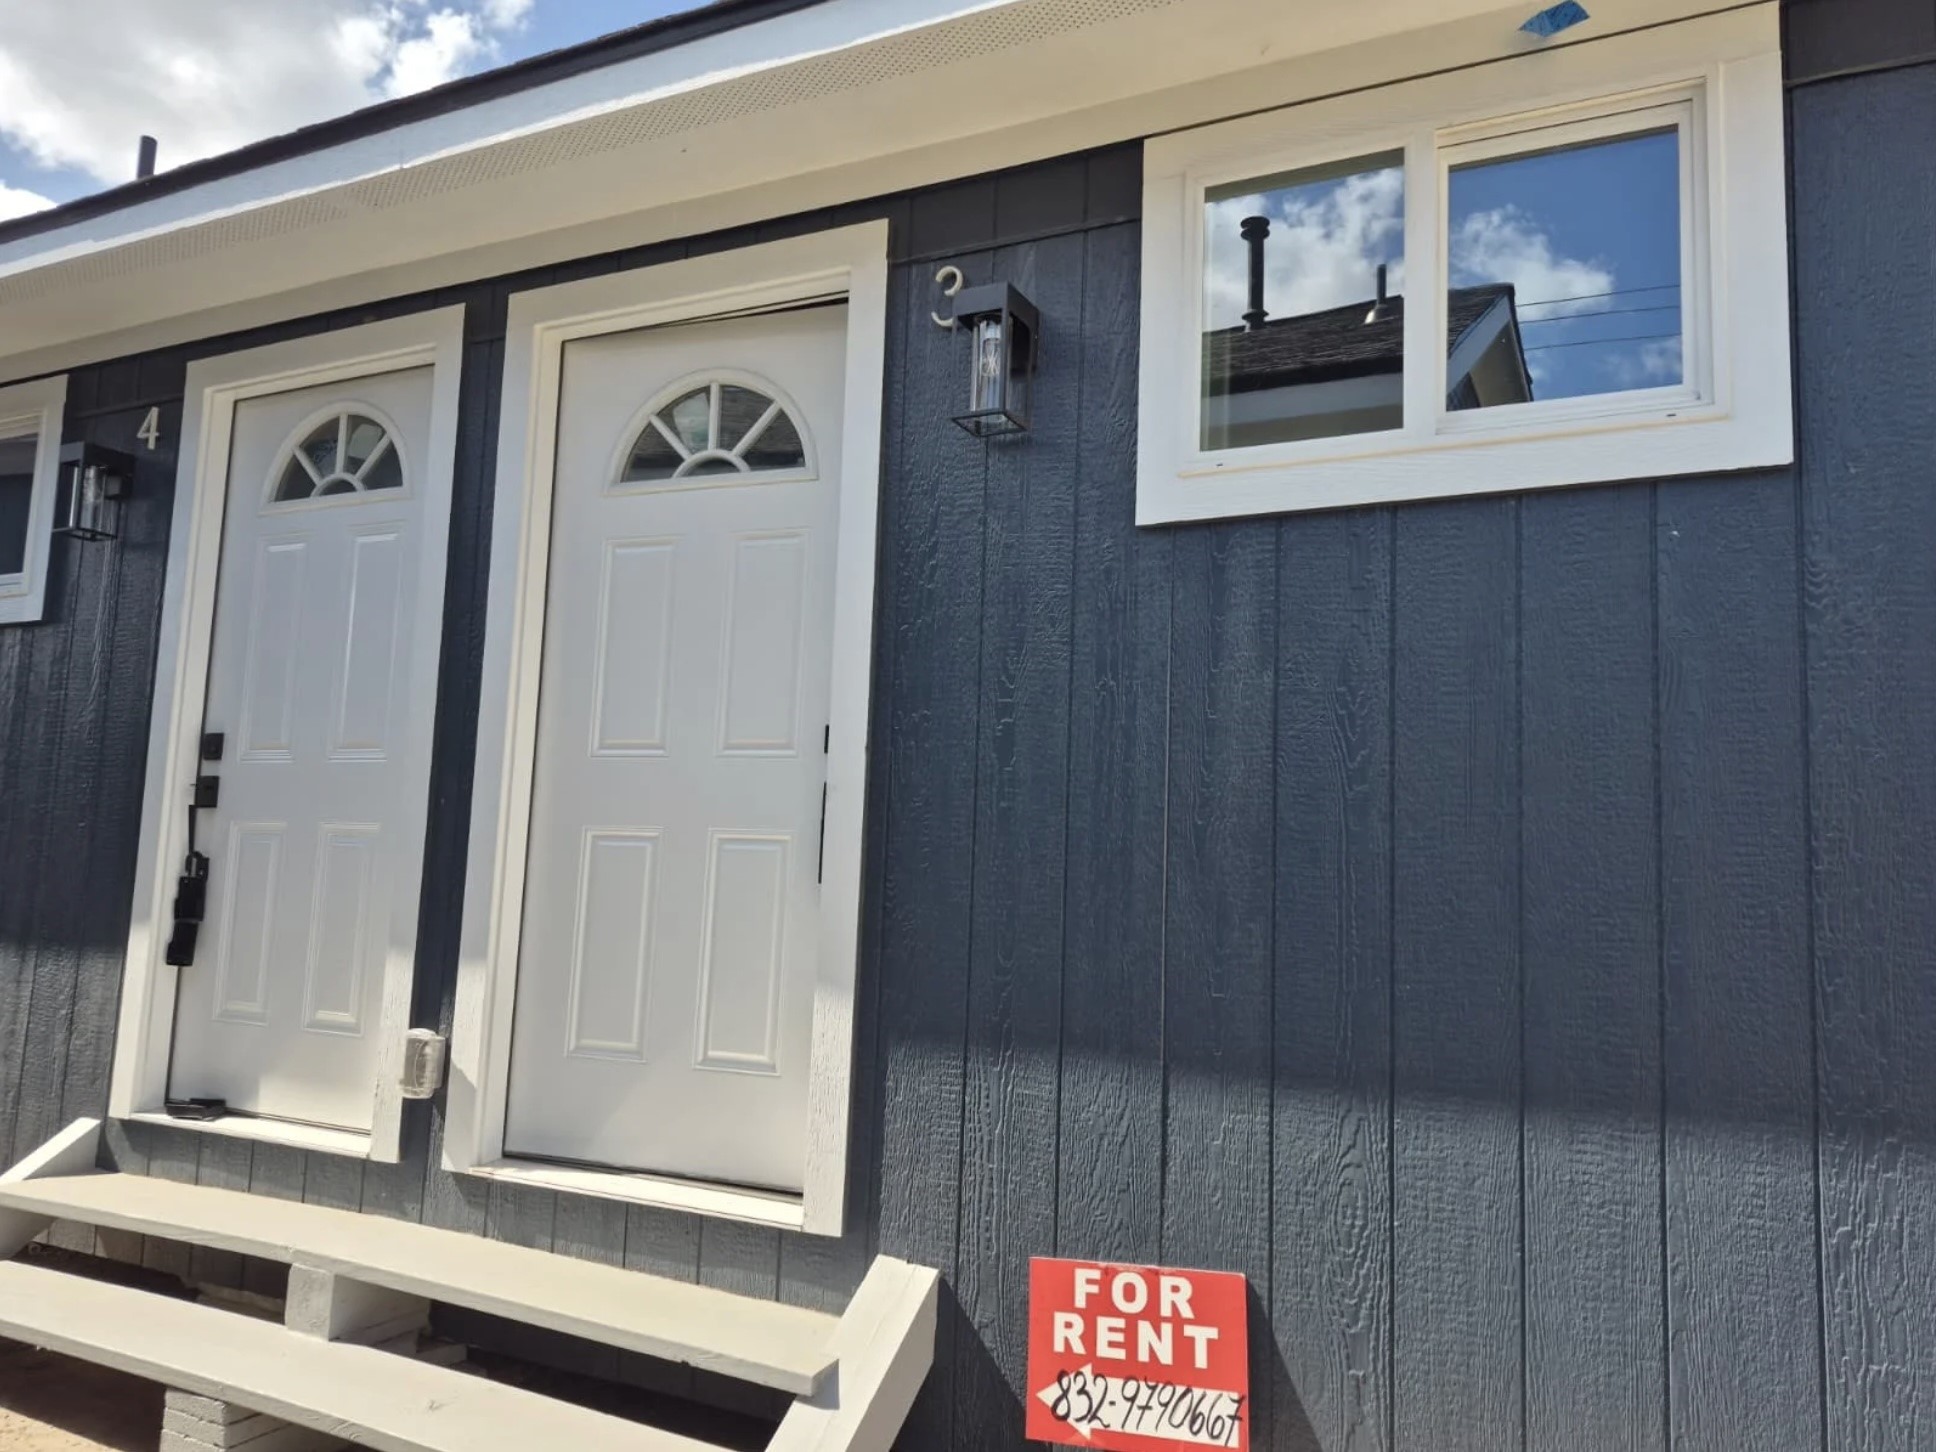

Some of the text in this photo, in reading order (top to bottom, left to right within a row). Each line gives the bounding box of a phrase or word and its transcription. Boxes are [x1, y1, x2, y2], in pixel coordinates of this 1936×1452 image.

[136, 406, 159, 450] 4
[1074, 1268, 1194, 1319] FOR
[1053, 1311, 1219, 1369] RENT
[1051, 1369, 1244, 1447] 832-9790667
